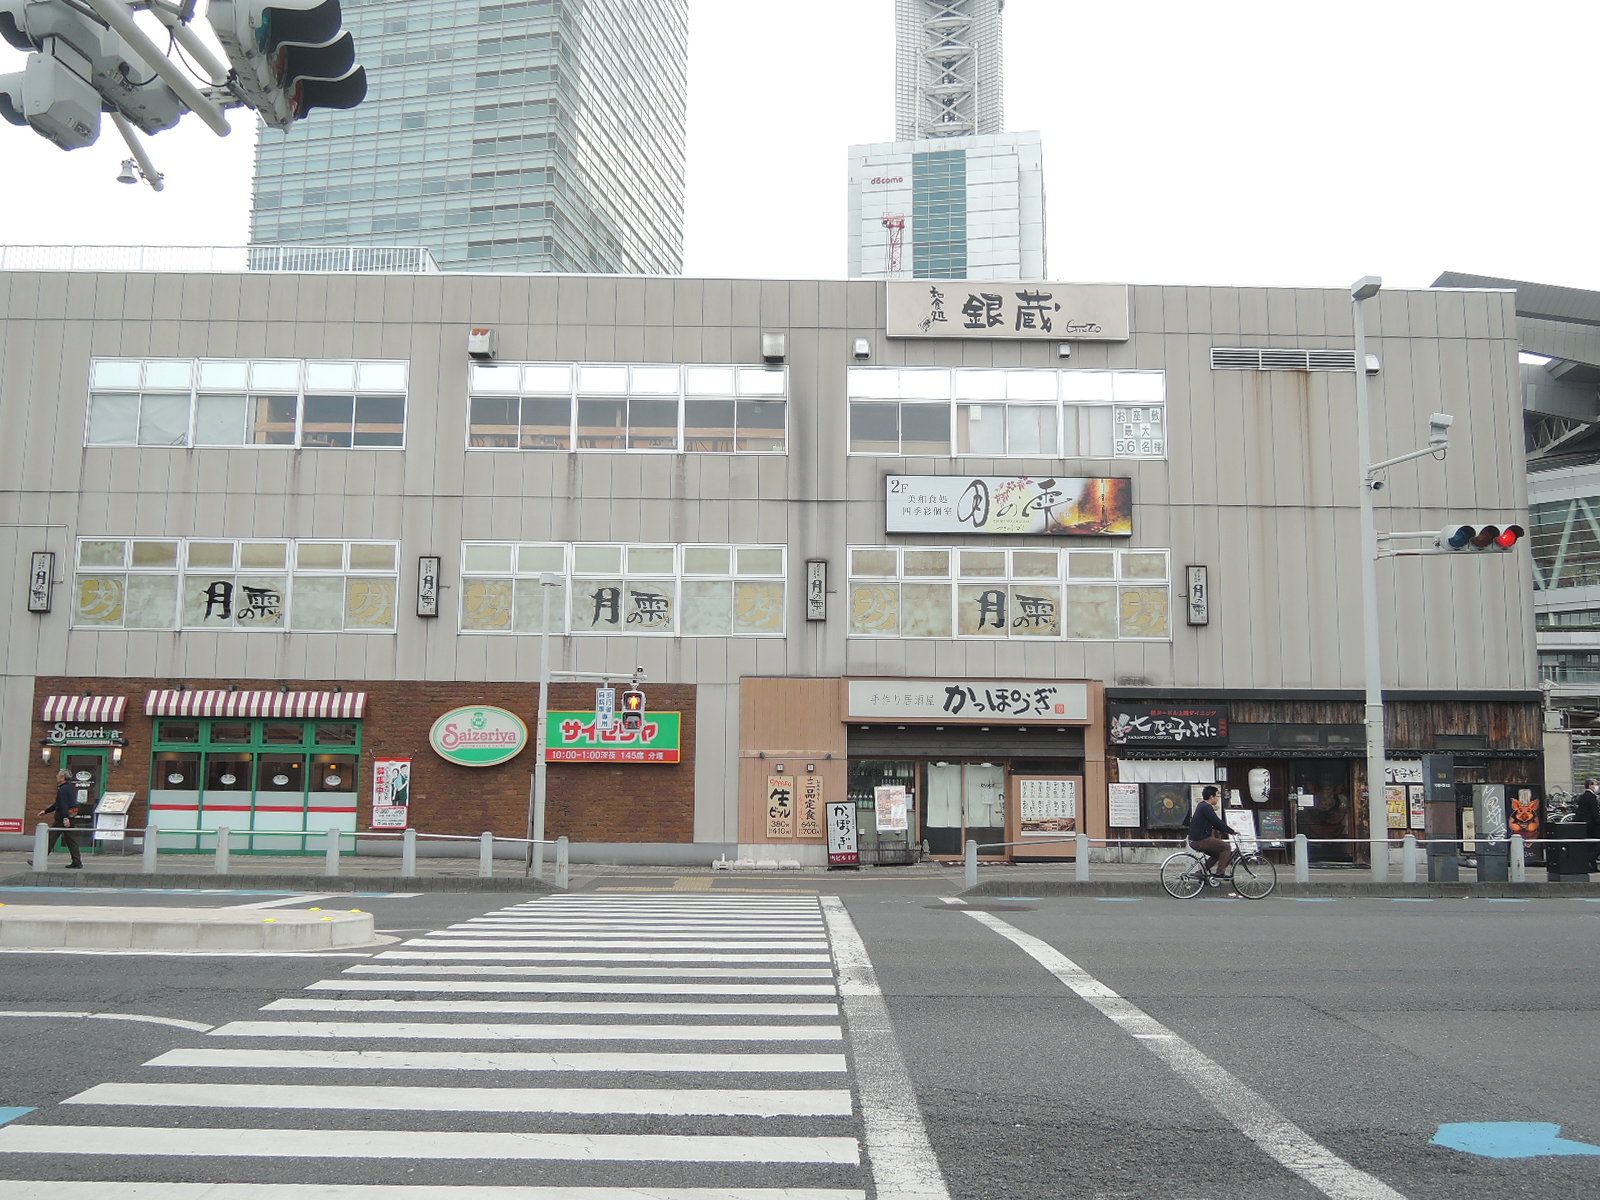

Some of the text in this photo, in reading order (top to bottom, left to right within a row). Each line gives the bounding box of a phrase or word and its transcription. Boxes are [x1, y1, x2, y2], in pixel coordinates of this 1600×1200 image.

[962, 290, 1060, 333] 銀蔵
[1116, 409, 1161, 422] お座敷
[1124, 424, 1150, 437] 最大
[1116, 440, 1163, 453] 56名様
[890, 479, 910, 494] 2F
[957, 478, 1073, 532] 月の雫
[202, 581, 281, 622] 月の雫
[421, 575, 435, 606] 月の雫
[809, 579, 824, 611] 月の雫
[589, 587, 669, 627] 月の雫
[974, 589, 1054, 631] 月の雫
[870, 694, 935, 706] 手作り居酒屋
[943, 684, 1057, 716] かっぽうぎ
[51, 722, 119, 742] Saizeriya
[442, 724, 516, 748] Saizeriya
[1129, 715, 1217, 741] 七匹の子ぶた
[770, 788, 790, 807] 生
[769, 806, 790, 818] ビール
